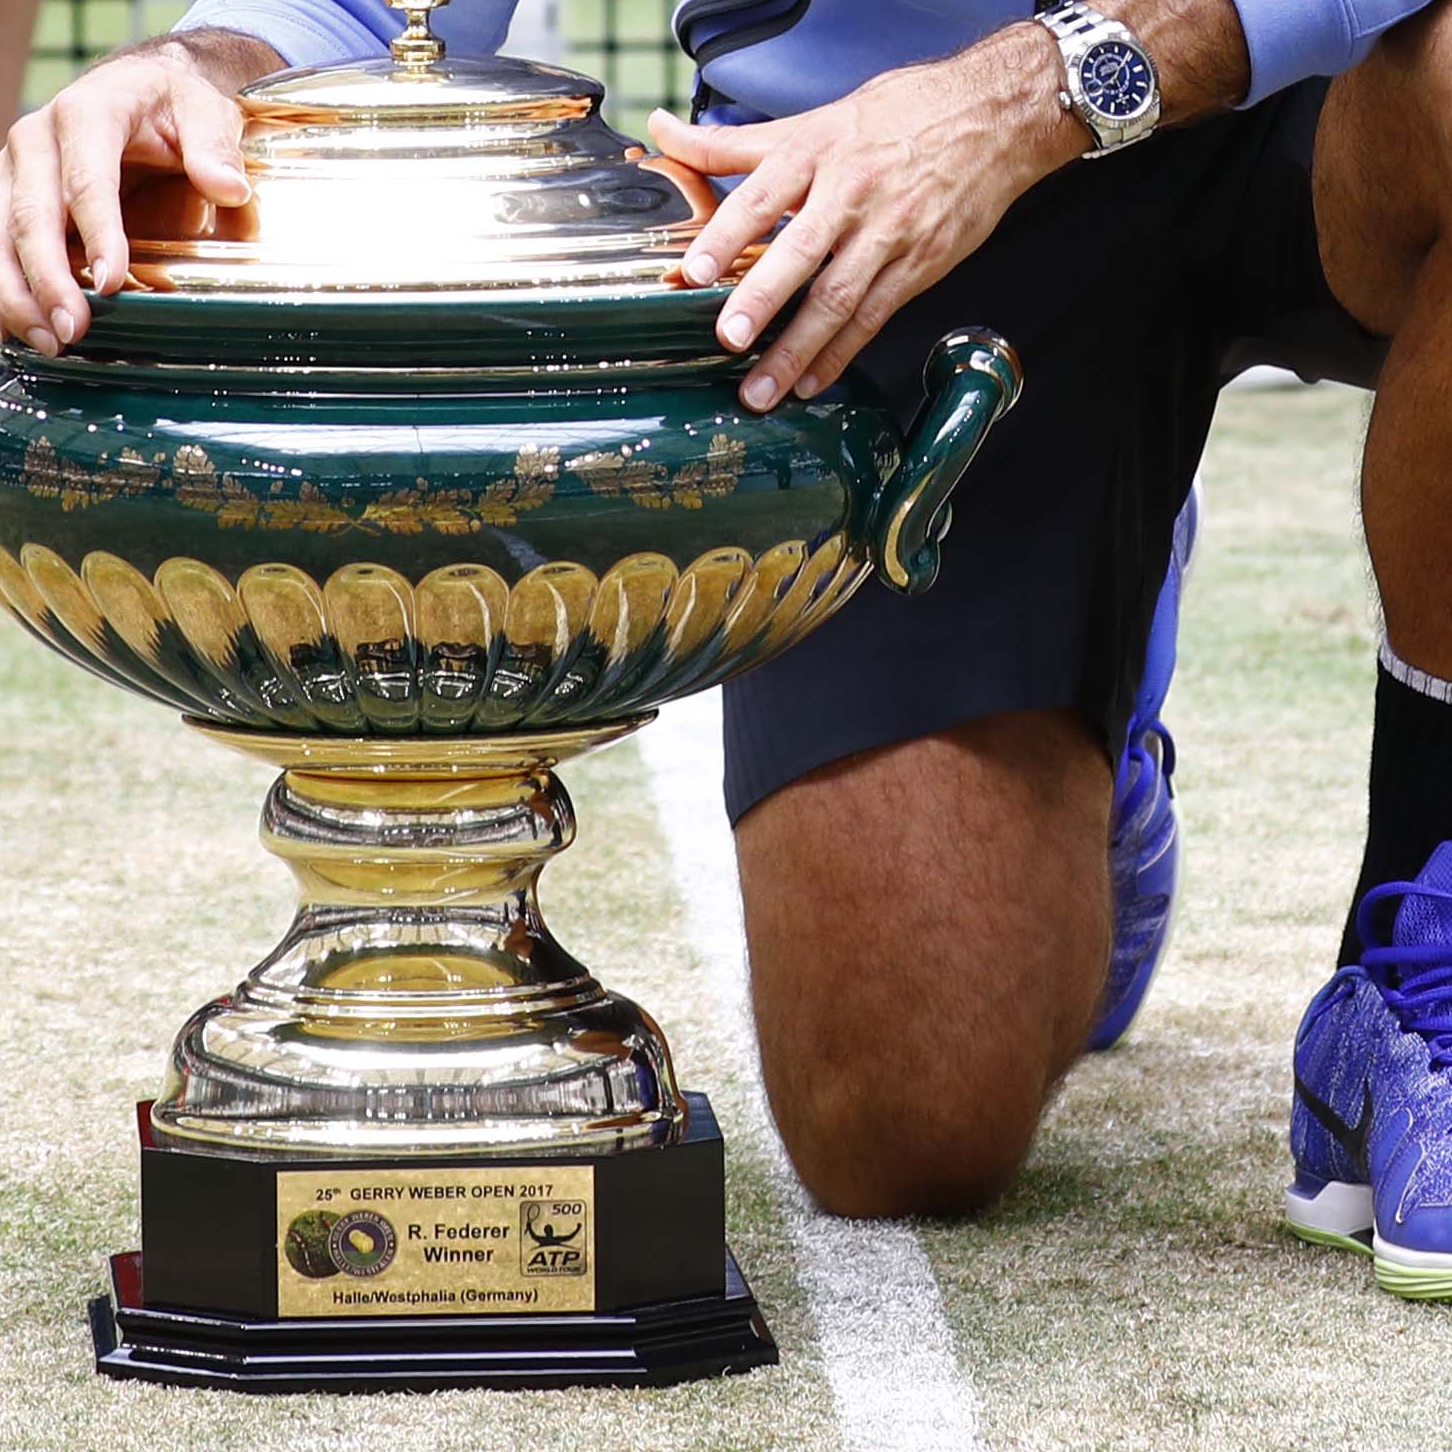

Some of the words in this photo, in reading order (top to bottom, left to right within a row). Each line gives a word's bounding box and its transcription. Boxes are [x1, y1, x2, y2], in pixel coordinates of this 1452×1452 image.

[350, 1188, 404, 1200] GERRY
[408, 1186, 466, 1199] WEBER
[471, 1185, 515, 1198] OPEN
[520, 1184, 554, 1197] 2017
[551, 1203, 582, 1216] 500
[408, 1225, 427, 1239] R.
[434, 1224, 510, 1239] Federer
[424, 1247, 494, 1263] Winner
[527, 1250, 581, 1267] ATP
[333, 1290, 456, 1306] Halle/Westphalia
[460, 1288, 539, 1304] (Germany)
